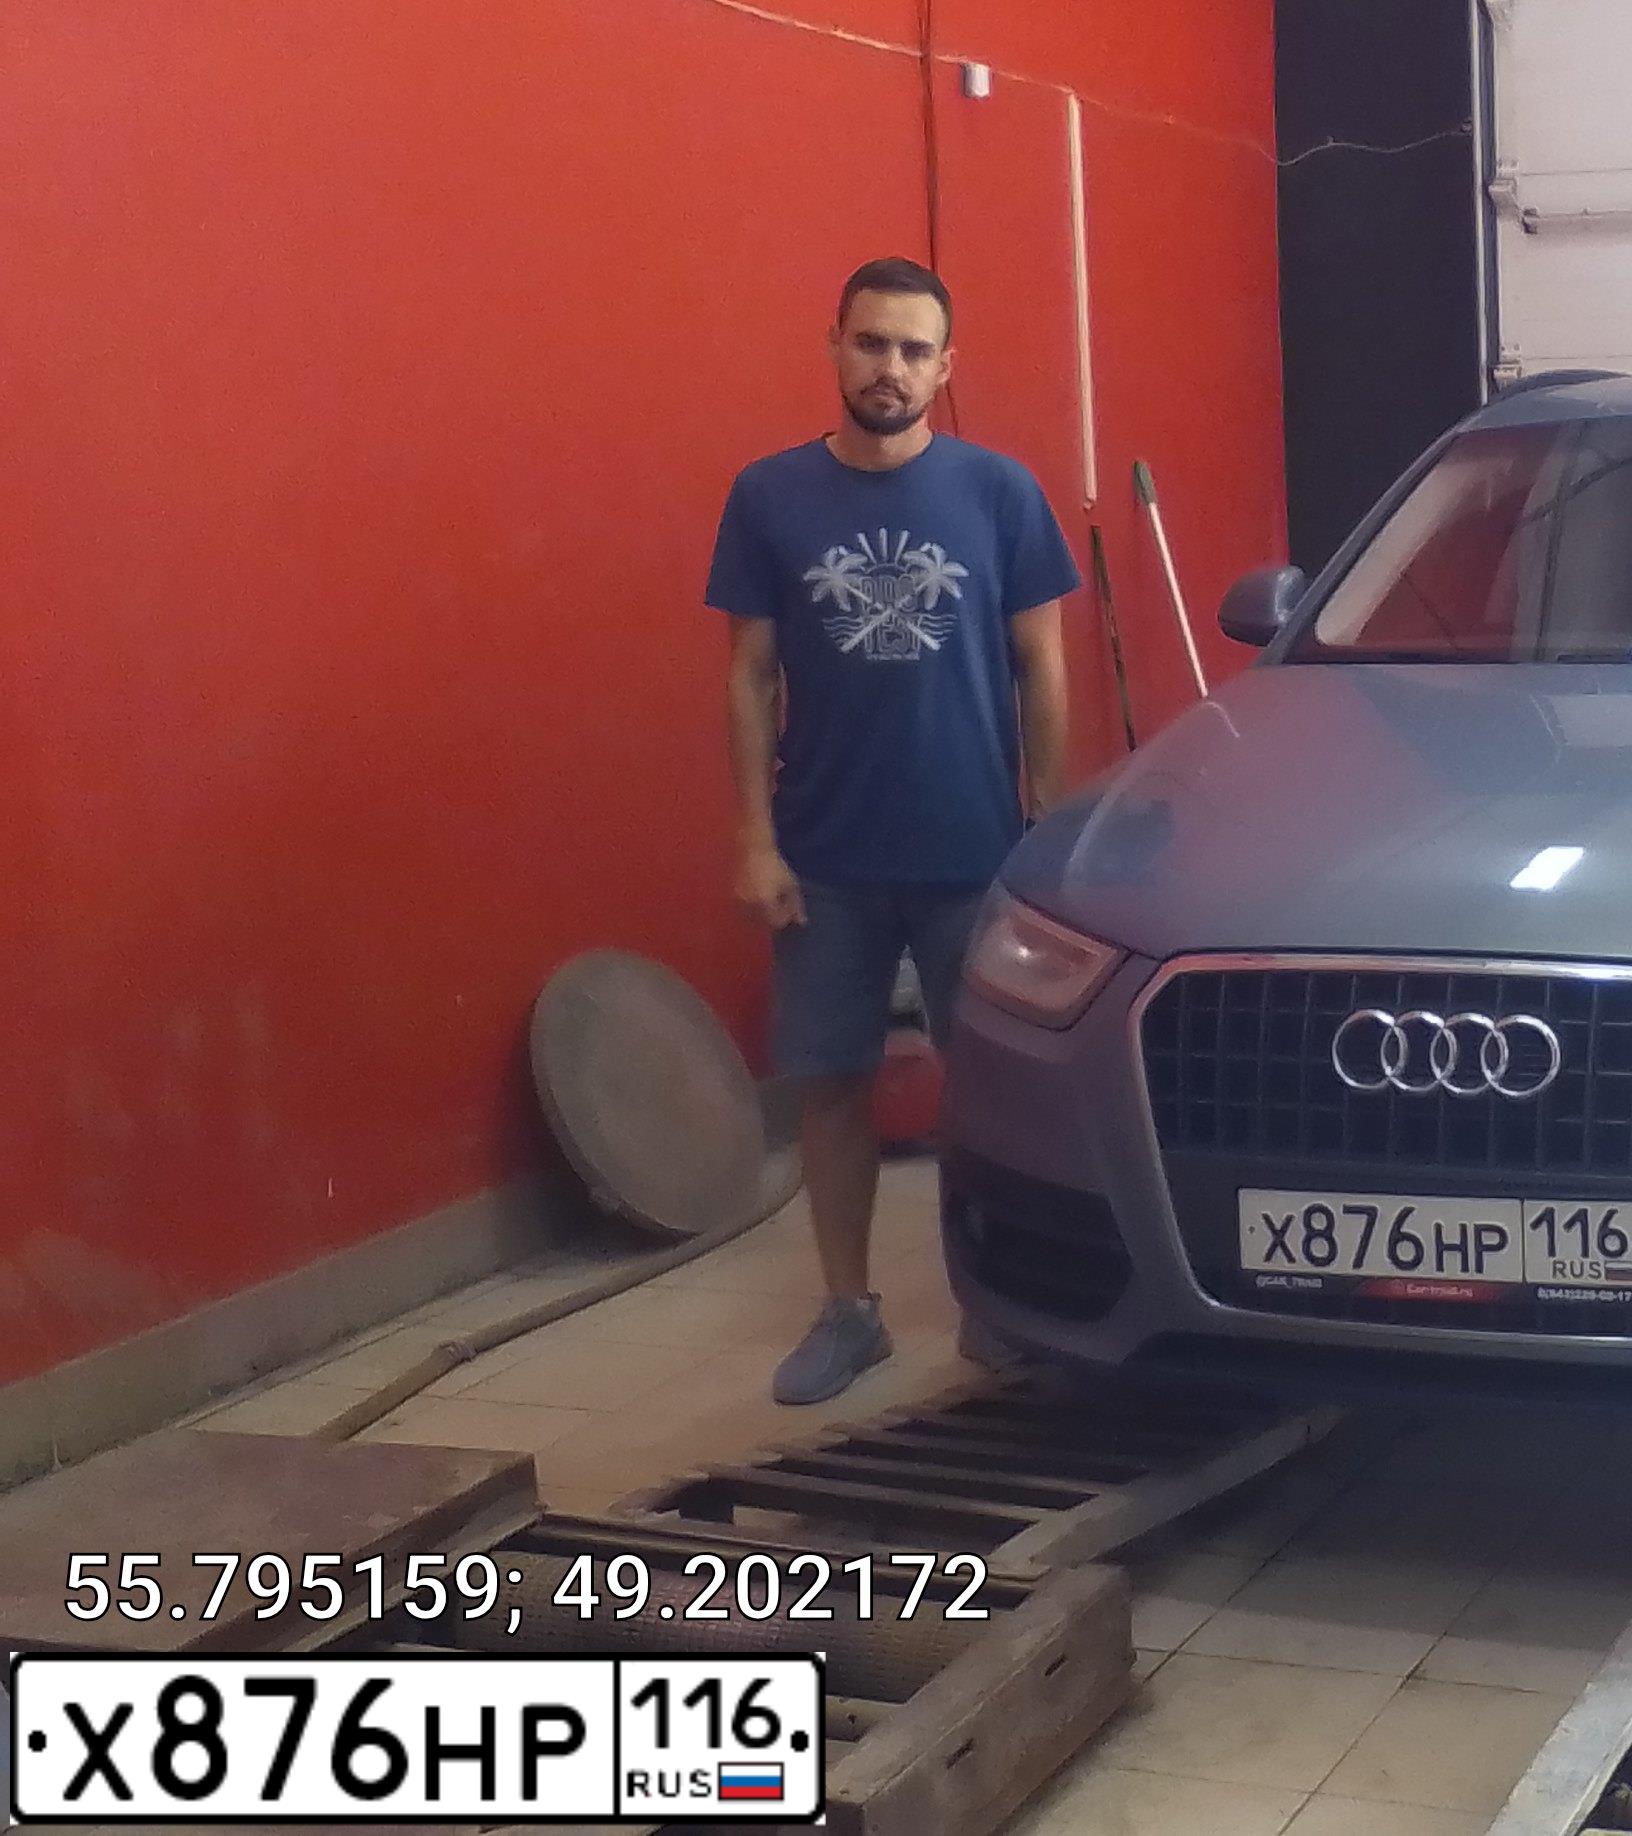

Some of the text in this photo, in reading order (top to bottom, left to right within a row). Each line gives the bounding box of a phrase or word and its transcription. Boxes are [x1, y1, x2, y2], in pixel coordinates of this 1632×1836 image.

[1262, 1203, 1630, 1275] Х876НР 116
[1552, 1260, 1602, 1280] RUS
